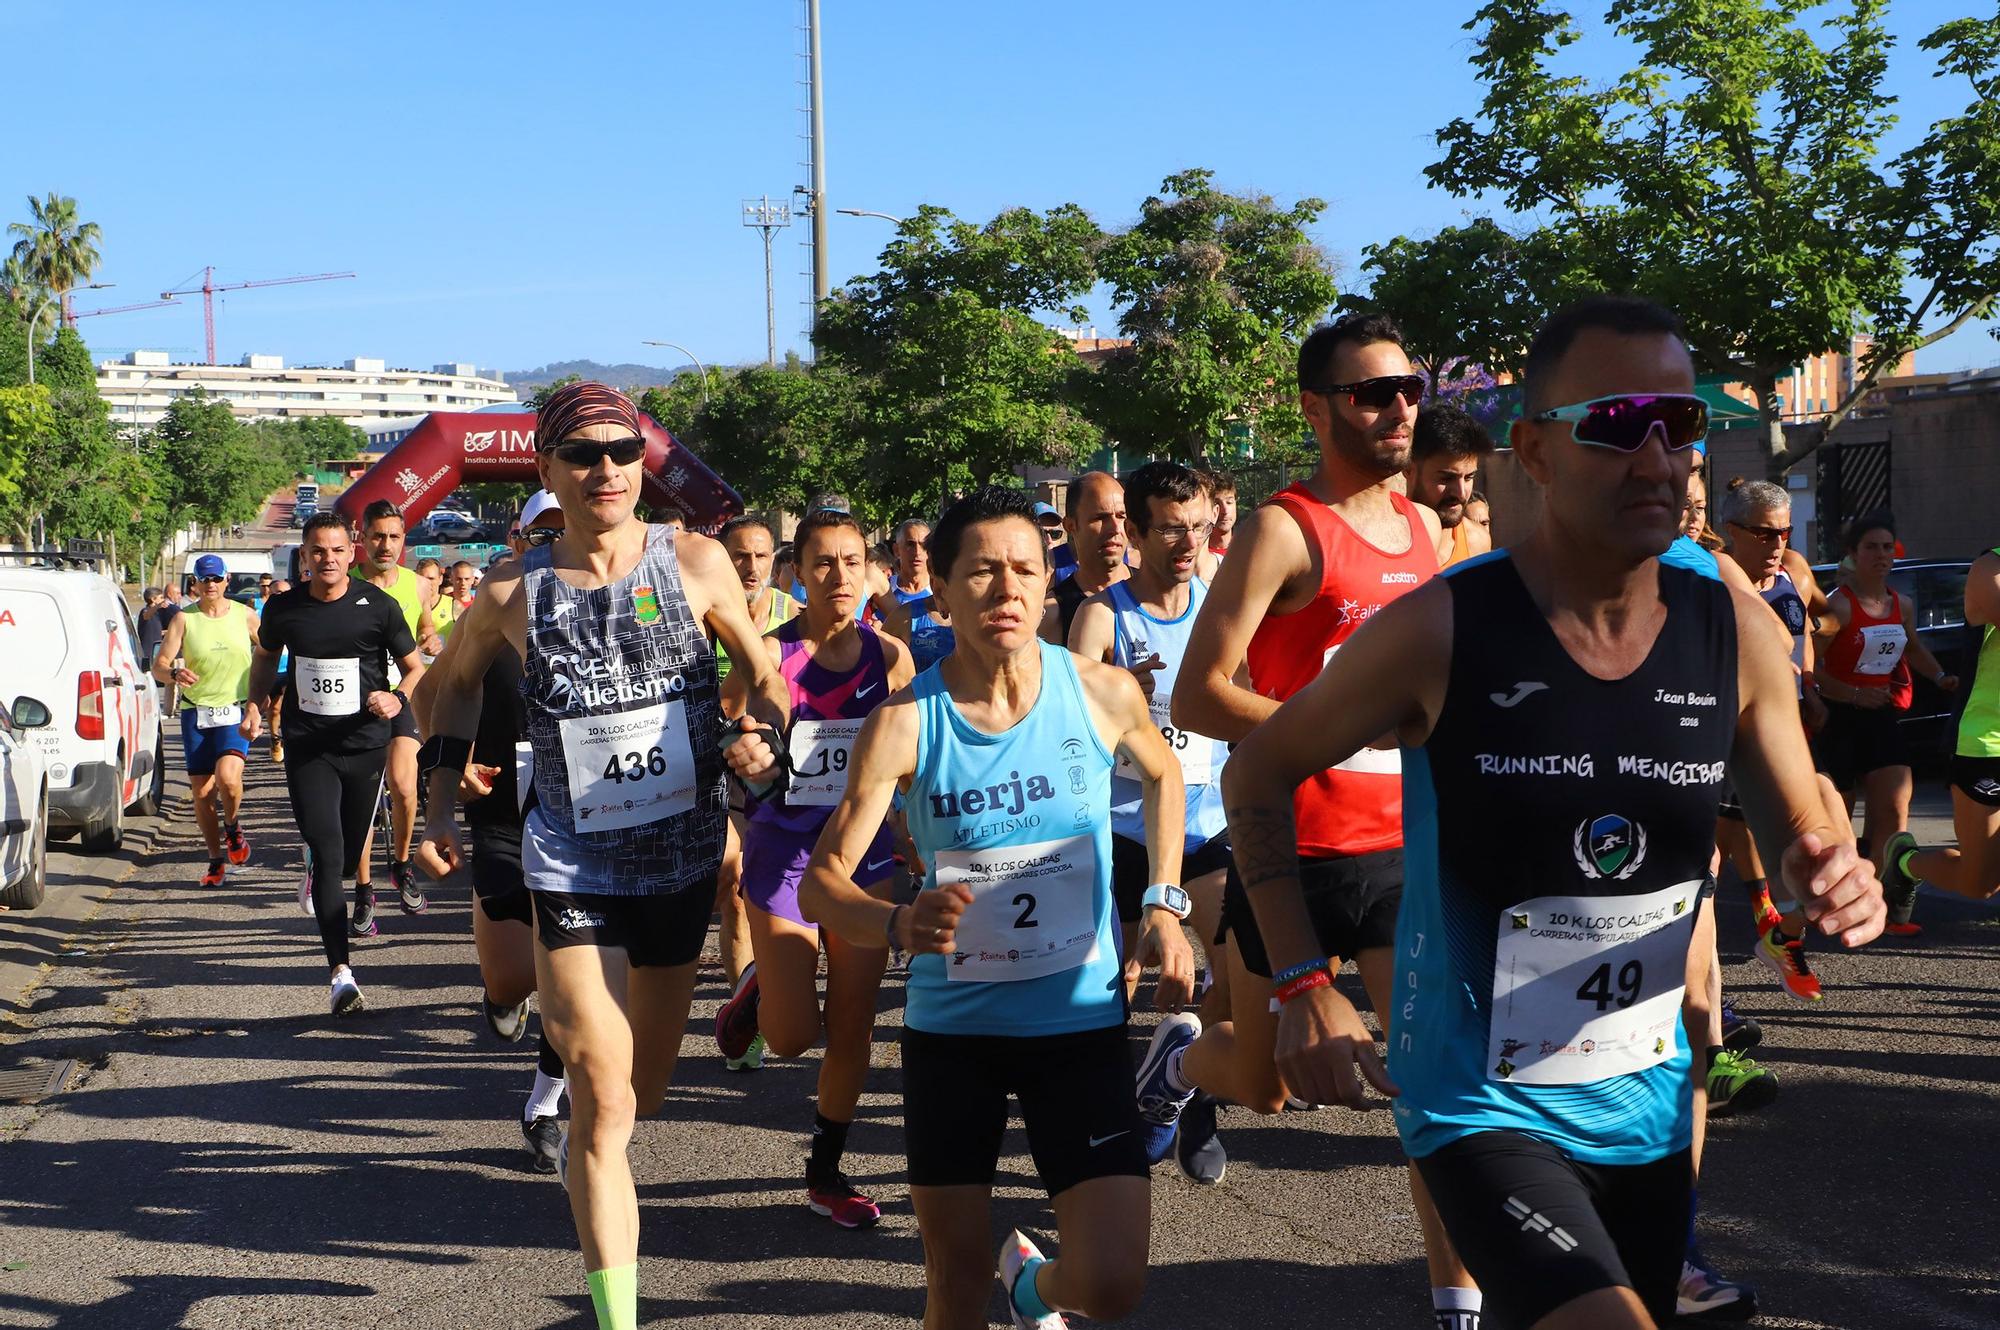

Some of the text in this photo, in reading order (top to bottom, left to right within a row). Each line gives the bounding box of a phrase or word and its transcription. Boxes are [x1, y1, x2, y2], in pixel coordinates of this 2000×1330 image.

[500, 429, 537, 452] IM
[464, 456, 536, 466] Instituto Municipa
[399, 488, 424, 512] TAMIENTO
[1352, 603, 1382, 620] calif
[1878, 641, 1896, 655] 32
[311, 678, 345, 694] 385
[566, 674, 686, 711] Atletismo
[1654, 689, 1685, 705] Jean
[208, 706, 231, 717] 380
[588, 717, 661, 736] 10 K LOS CALIFAS
[44, 737, 60, 745] 207
[580, 735, 611, 746] CARRERAS
[603, 746, 667, 784] 436
[817, 748, 848, 772] 19
[1475, 753, 1595, 778] RUNNING
[929, 770, 1056, 818] nerja
[952, 814, 1042, 843] ATLETISMO
[970, 852, 1062, 873] 10 K LOS CALIFAS
[958, 874, 996, 884] CARRERAS
[997, 869, 1040, 882] POPULARES
[1012, 893, 1039, 929] 2
[1549, 906, 1665, 930] 10 K LOS CALIFAS
[1529, 928, 1584, 942] CARRERAS
[1586, 928, 1638, 942] POPULARES
[1400, 932, 1425, 1053] Jaén
[1576, 959, 1644, 1012] 49
